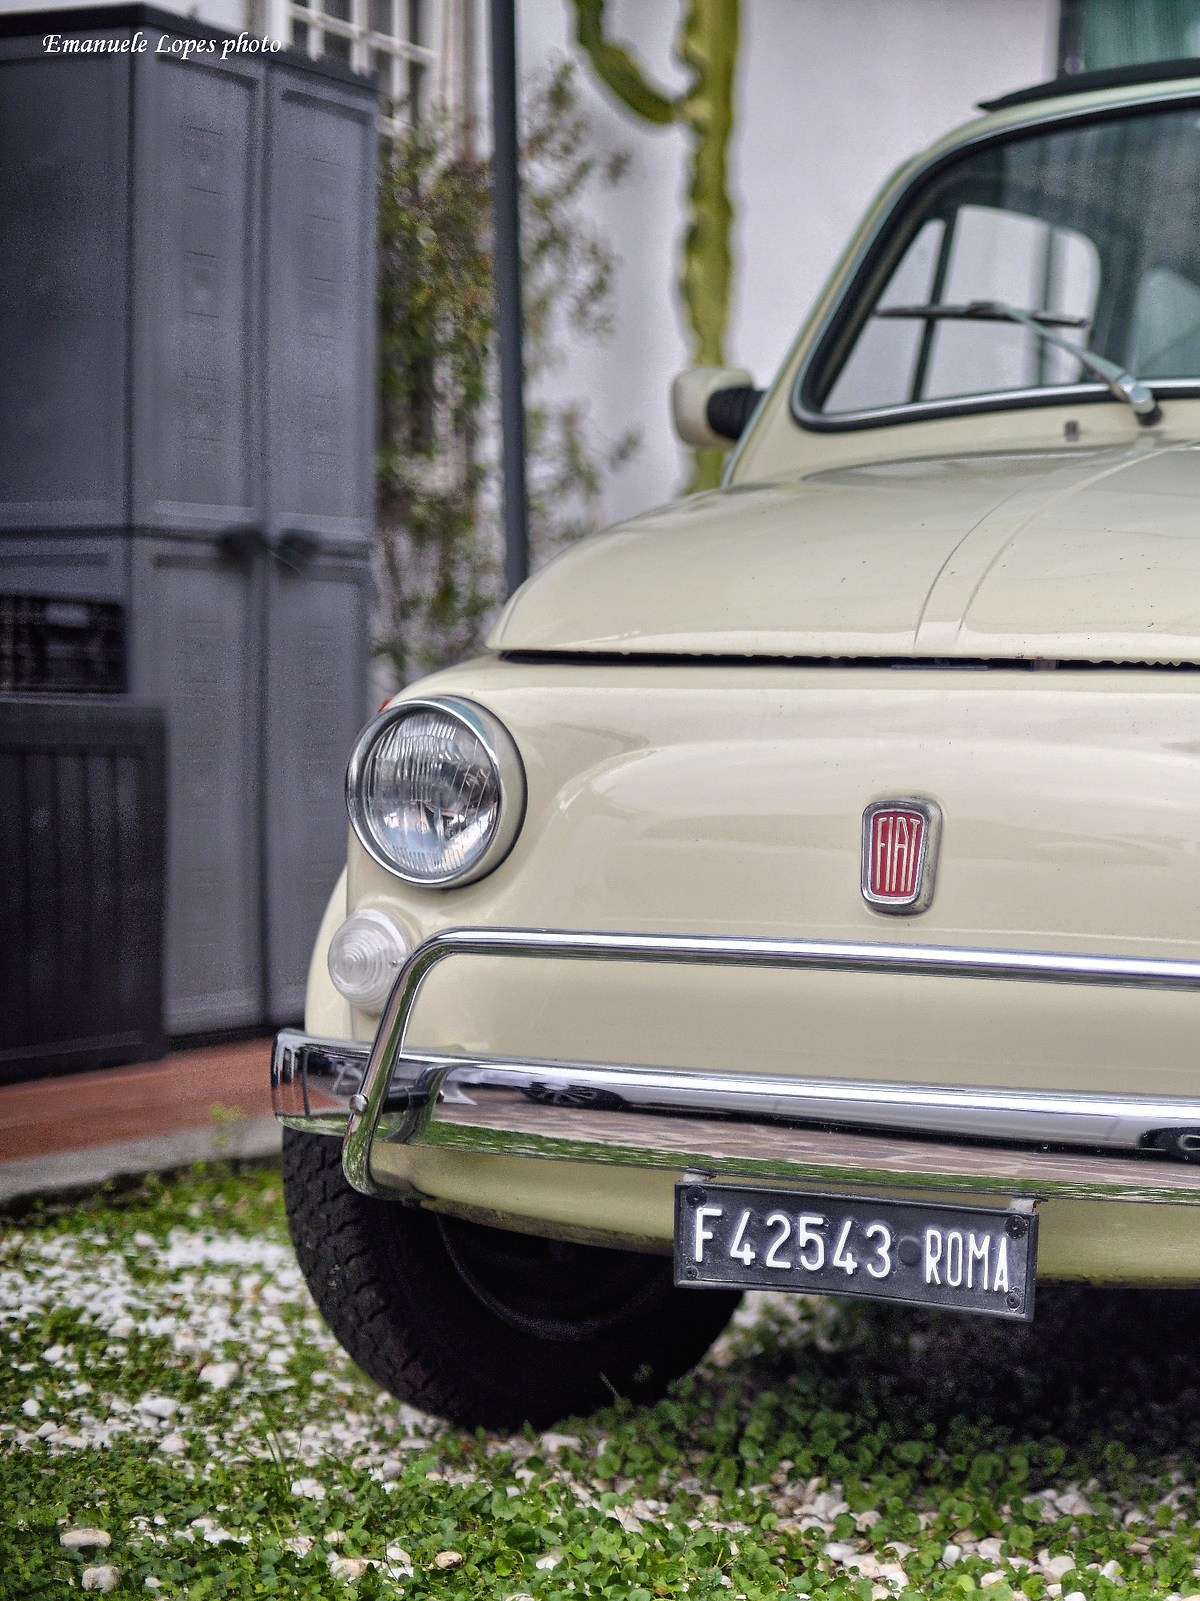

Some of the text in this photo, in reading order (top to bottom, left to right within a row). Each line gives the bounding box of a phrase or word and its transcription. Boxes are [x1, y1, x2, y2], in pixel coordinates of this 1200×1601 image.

[876, 816, 921, 892] FIAT
[695, 1207, 1009, 1293] F42543 ROMA
